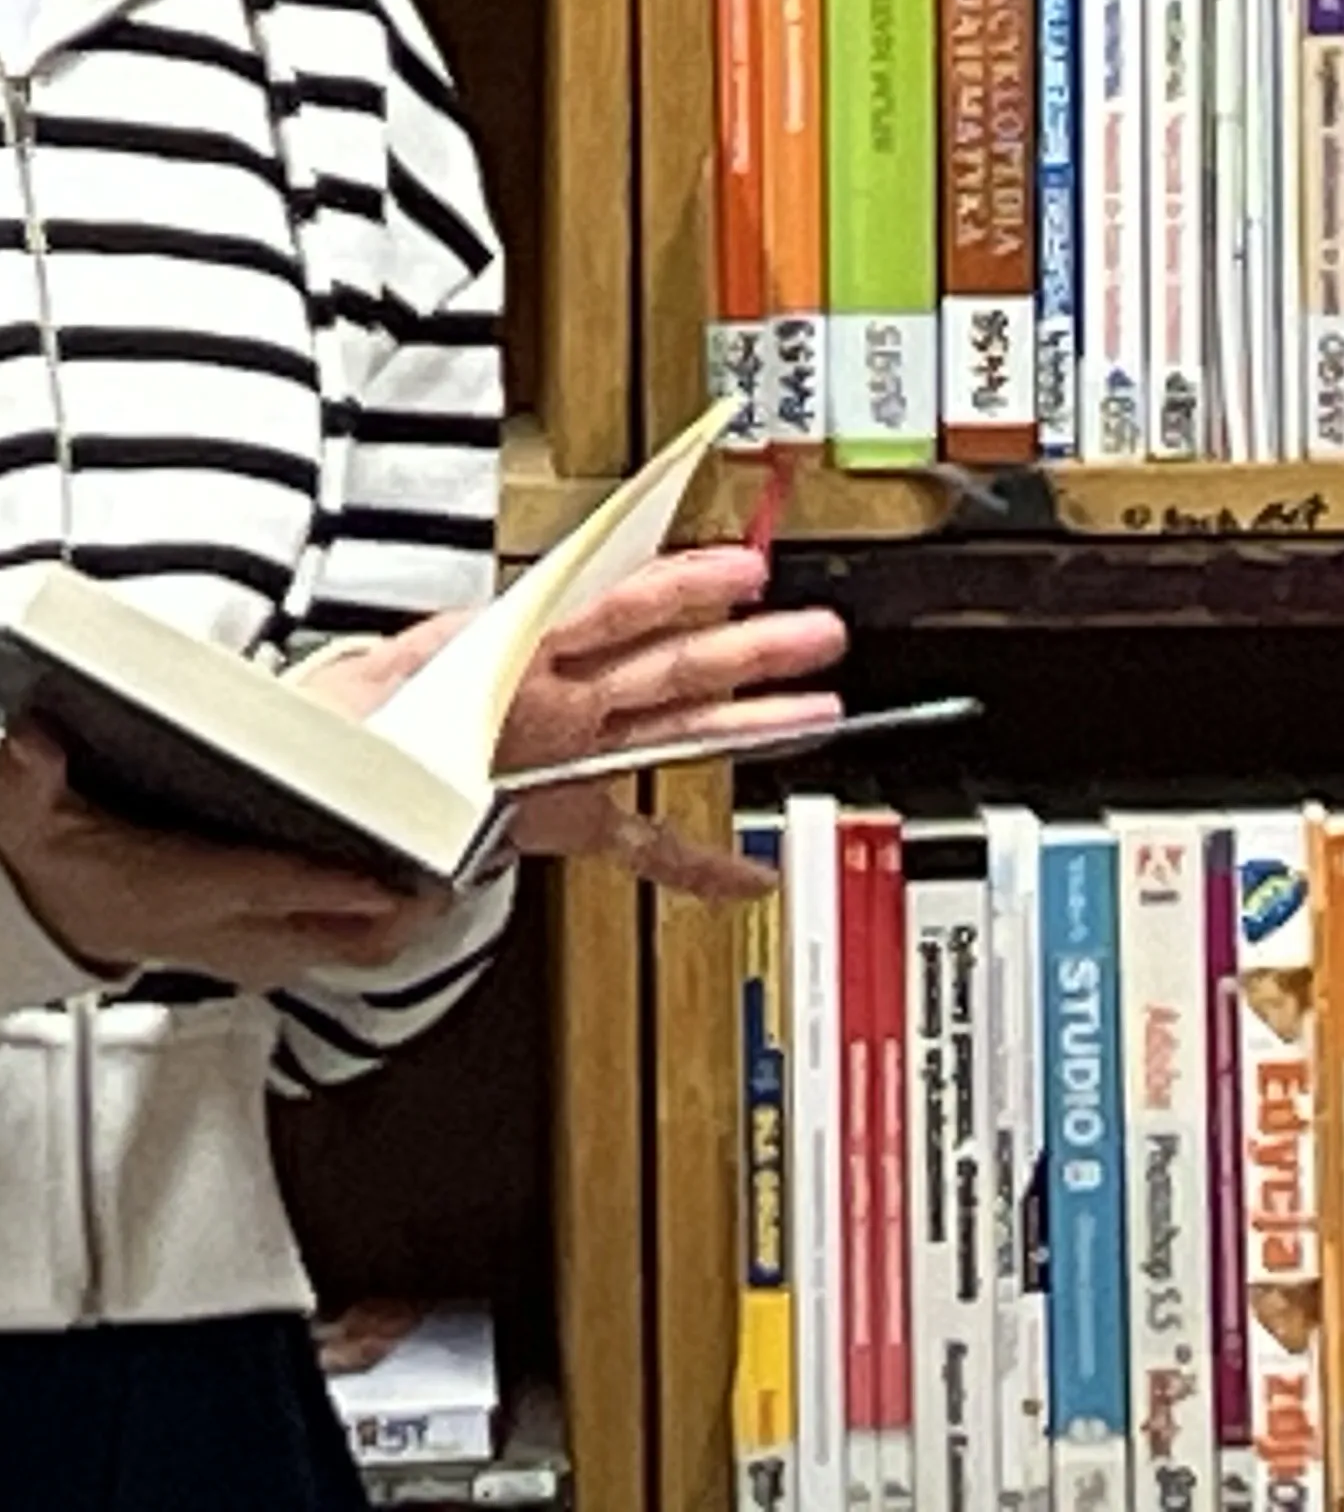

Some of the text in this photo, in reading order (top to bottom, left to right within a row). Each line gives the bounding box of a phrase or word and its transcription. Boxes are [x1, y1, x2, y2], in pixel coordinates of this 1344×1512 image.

[1058, 957, 1105, 1192] STUDIO 8
[1144, 1004, 1179, 1109] Adobe
[1142, 1133, 1180, 1280] Photoshop
[1249, 1059, 1310, 1272] Edycja
